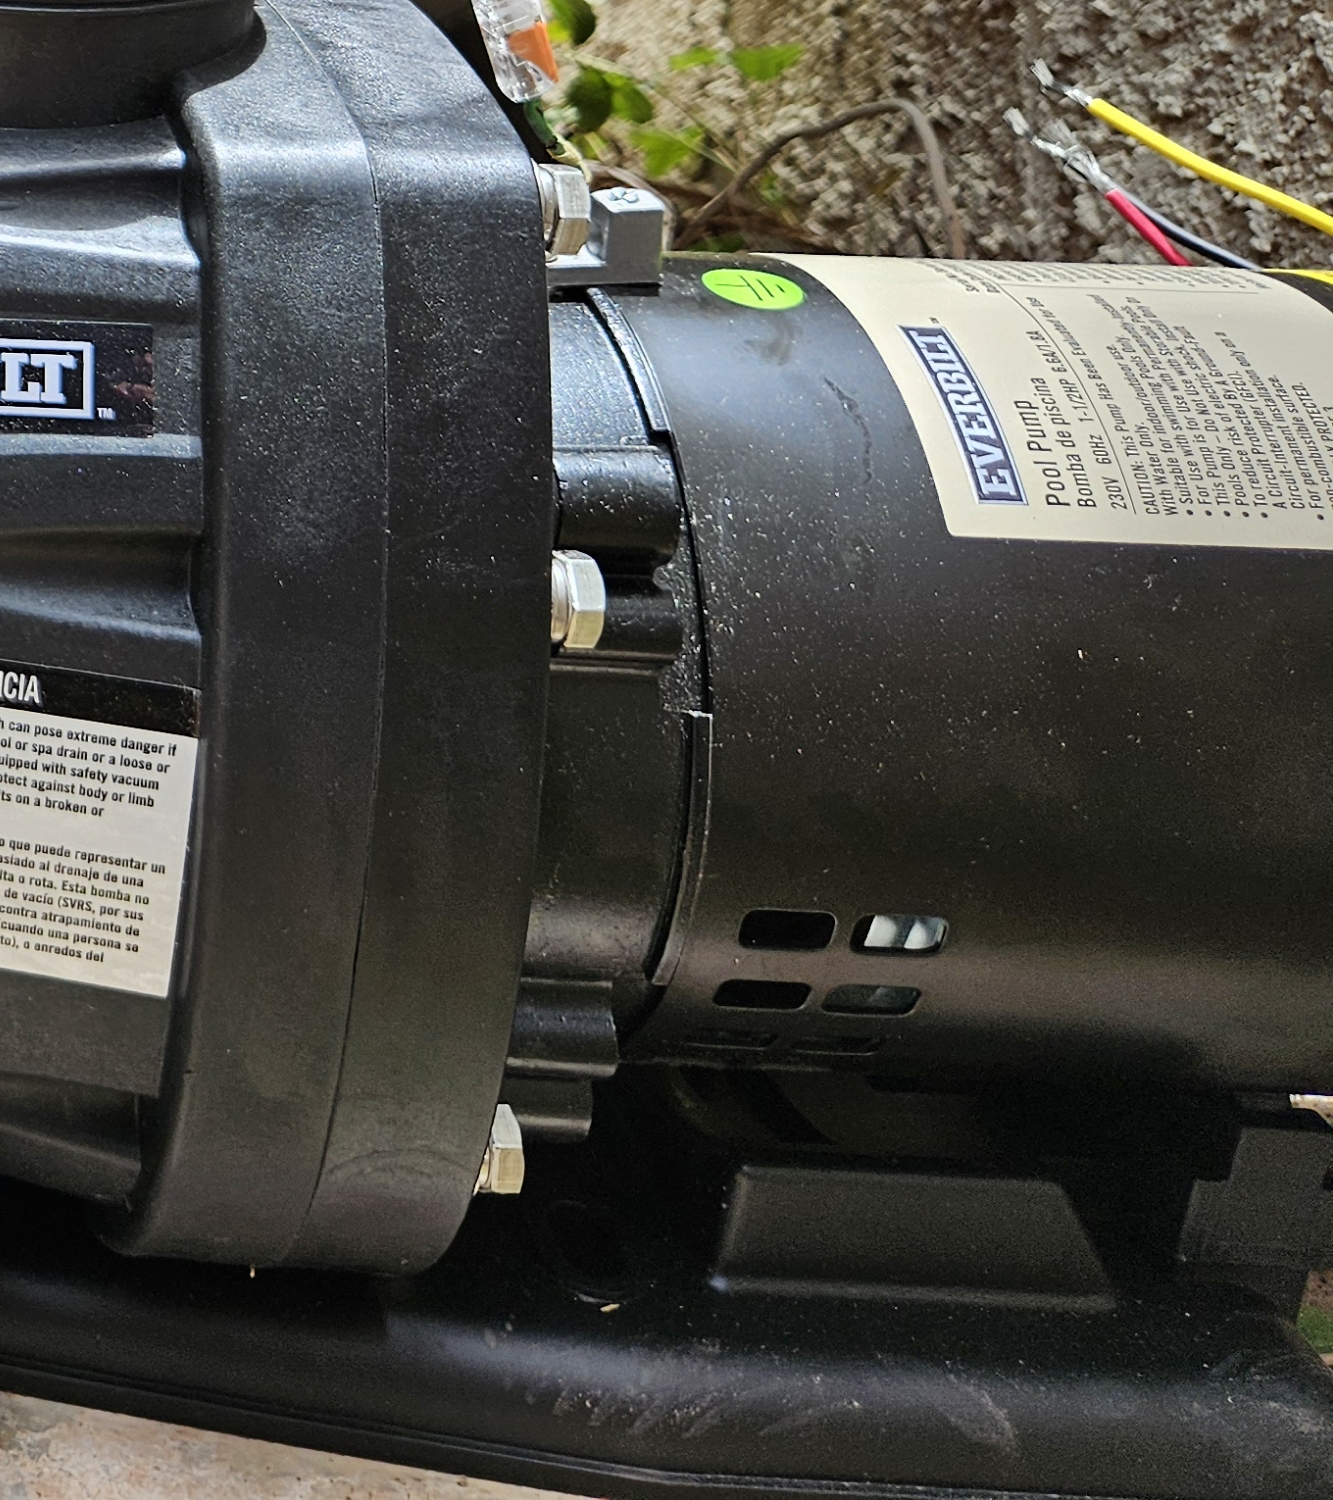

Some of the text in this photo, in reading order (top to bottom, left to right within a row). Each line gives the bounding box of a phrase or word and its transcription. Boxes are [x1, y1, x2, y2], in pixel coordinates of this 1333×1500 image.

[1026, 296, 1044, 306] Use
[1038, 307, 1056, 317] for
[1080, 358, 1102, 379] Been
[1059, 377, 1094, 421] 1-1/2HP
[1095, 382, 1114, 399] Has
[1117, 361, 1166, 433] indoor/outdoor
[1181, 378, 1200, 395] Use
[908, 330, 1017, 497] EVERBILT
[1106, 403, 1129, 431] Pump
[1173, 394, 1191, 411] Use
[1013, 400, 1071, 505] Pool Pump
[1030, 377, 1097, 507] Bomba de piscina
[1089, 433, 1112, 464] 60Hz
[1121, 435, 1140, 456] This
[1158, 437, 1175, 453] for
[1146, 450, 1168, 484] Water
[1166, 456, 1193, 503] Suitable
[1187, 460, 1203, 480] Use
[1102, 476, 1127, 509] 230V
[1130, 460, 1160, 513] CAUTION:
[1159, 488, 1178, 514] With
[8, 721, 31, 734] can
[33, 725, 63, 739] pose
[66, 730, 117, 747] extreme
[120, 736, 166, 755] danger
[167, 742, 178, 757] if
[14, 740, 29, 752] or
[31, 742, 53, 757] spa
[56, 744, 88, 762] drain
[91, 752, 106, 764] or
[107, 755, 116, 766] a
[119, 754, 153, 772] loose
[156, 762, 171, 774] or
[41, 761, 67, 776] with
[69, 766, 109, 785] safety
[111, 773, 160, 791] vacuum
[15, 794, 30, 806] on
[33, 797, 41, 808] a
[44, 795, 87, 815] broken
[90, 806, 105, 818] or
[30, 778, 76, 795] against
[78, 783, 109, 802] body
[111, 791, 126, 803] or
[127, 791, 155, 808] limb
[8, 839, 31, 852] que
[33, 843, 72, 858] puede
[74, 850, 148, 872] representar
[150, 863, 166, 875] un
[38, 860, 51, 872] al
[53, 861, 100, 882] drenaje
[103, 870, 119, 884] de
[121, 875, 144, 888] una
